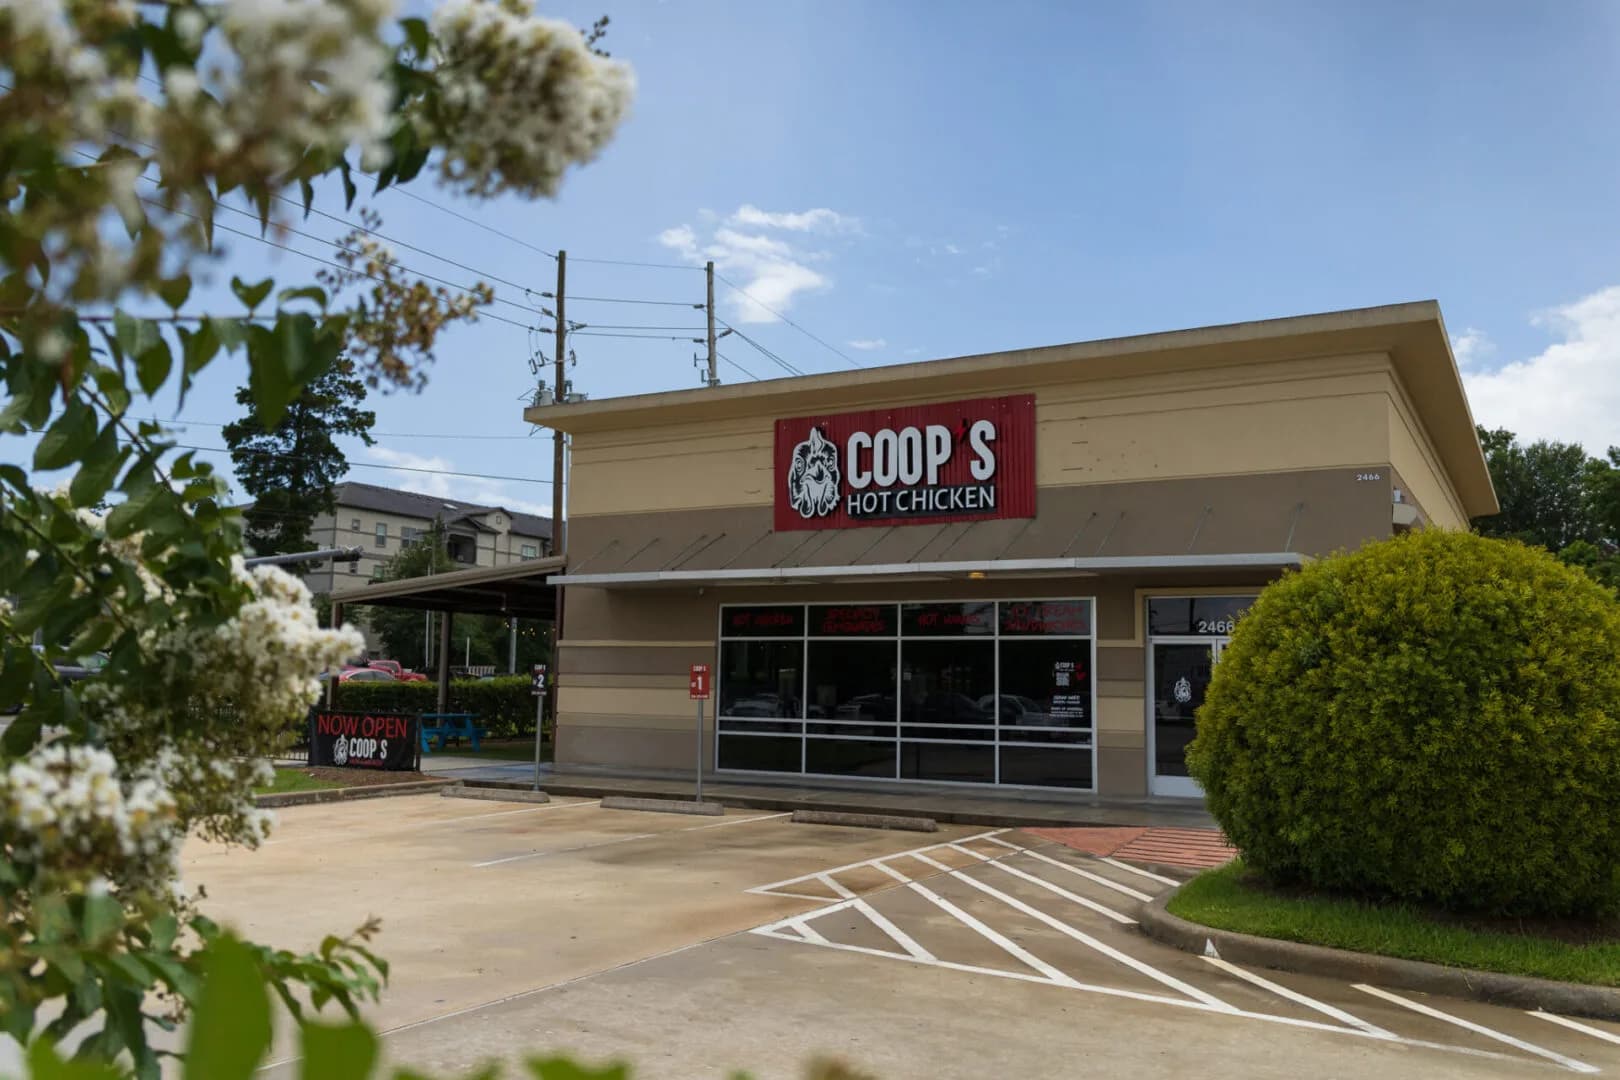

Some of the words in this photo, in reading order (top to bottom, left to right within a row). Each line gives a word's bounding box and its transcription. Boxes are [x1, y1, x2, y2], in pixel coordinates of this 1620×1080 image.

[847, 419, 996, 488] COOP'S
[1356, 473, 1380, 481] 2466
[848, 491, 891, 515] HOT
[895, 486, 995, 511] CHICKEN
[1198, 621, 1235, 633] 2466
[537, 674, 544, 688] 2
[697, 676, 702, 690] 1
[318, 715, 359, 735] NOW
[362, 716, 407, 738] OPEN
[349, 737, 388, 759] COOPS
